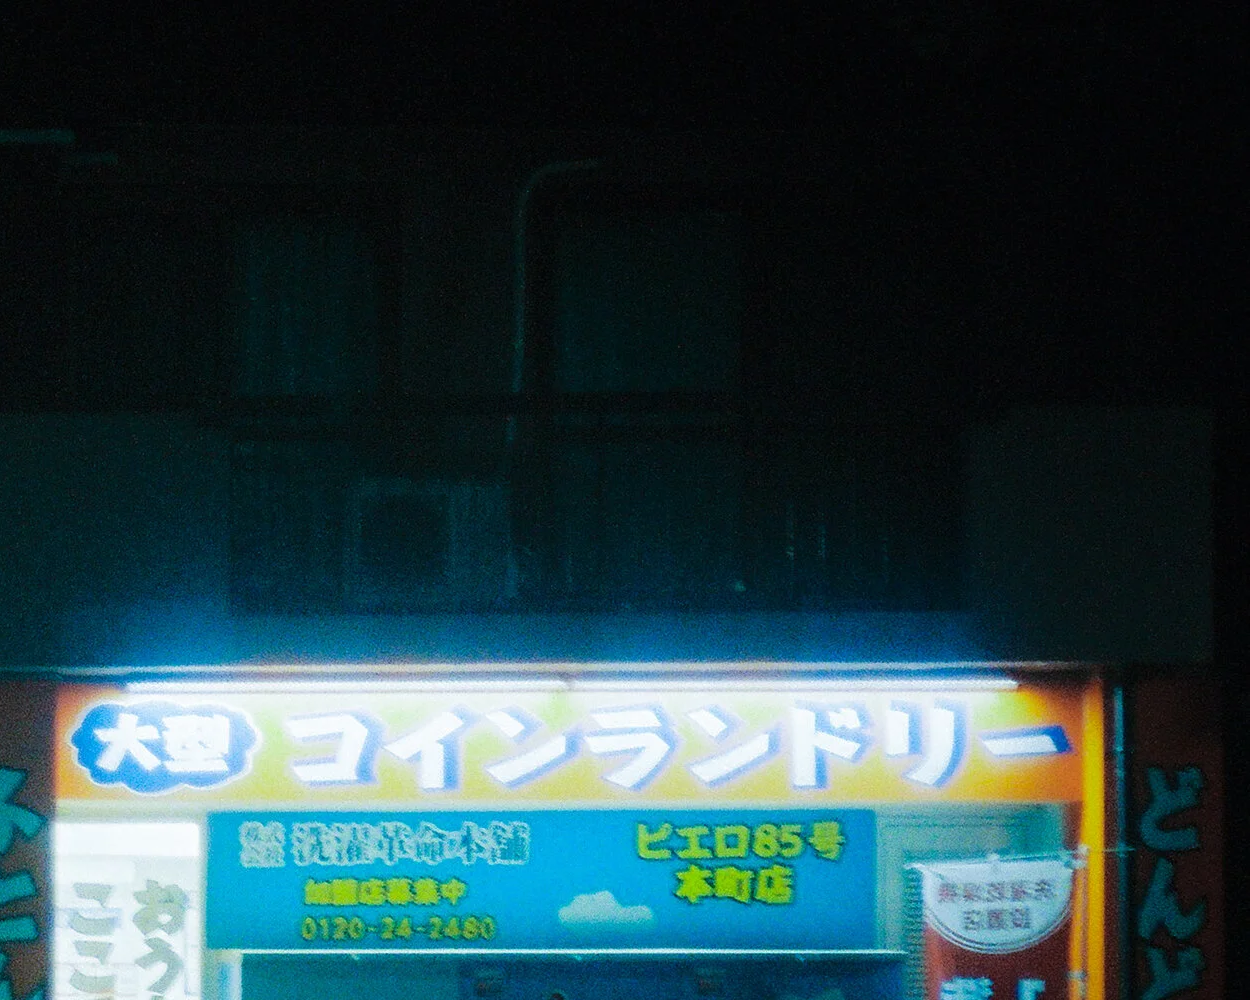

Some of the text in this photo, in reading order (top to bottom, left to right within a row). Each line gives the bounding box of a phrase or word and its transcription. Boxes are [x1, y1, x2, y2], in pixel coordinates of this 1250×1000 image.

[95, 706, 1073, 793] 大型 コインランドリー
[636, 821, 846, 861] ピエロ85号
[673, 865, 795, 905] 本町店
[301, 916, 496, 942] 0120-24-2480
